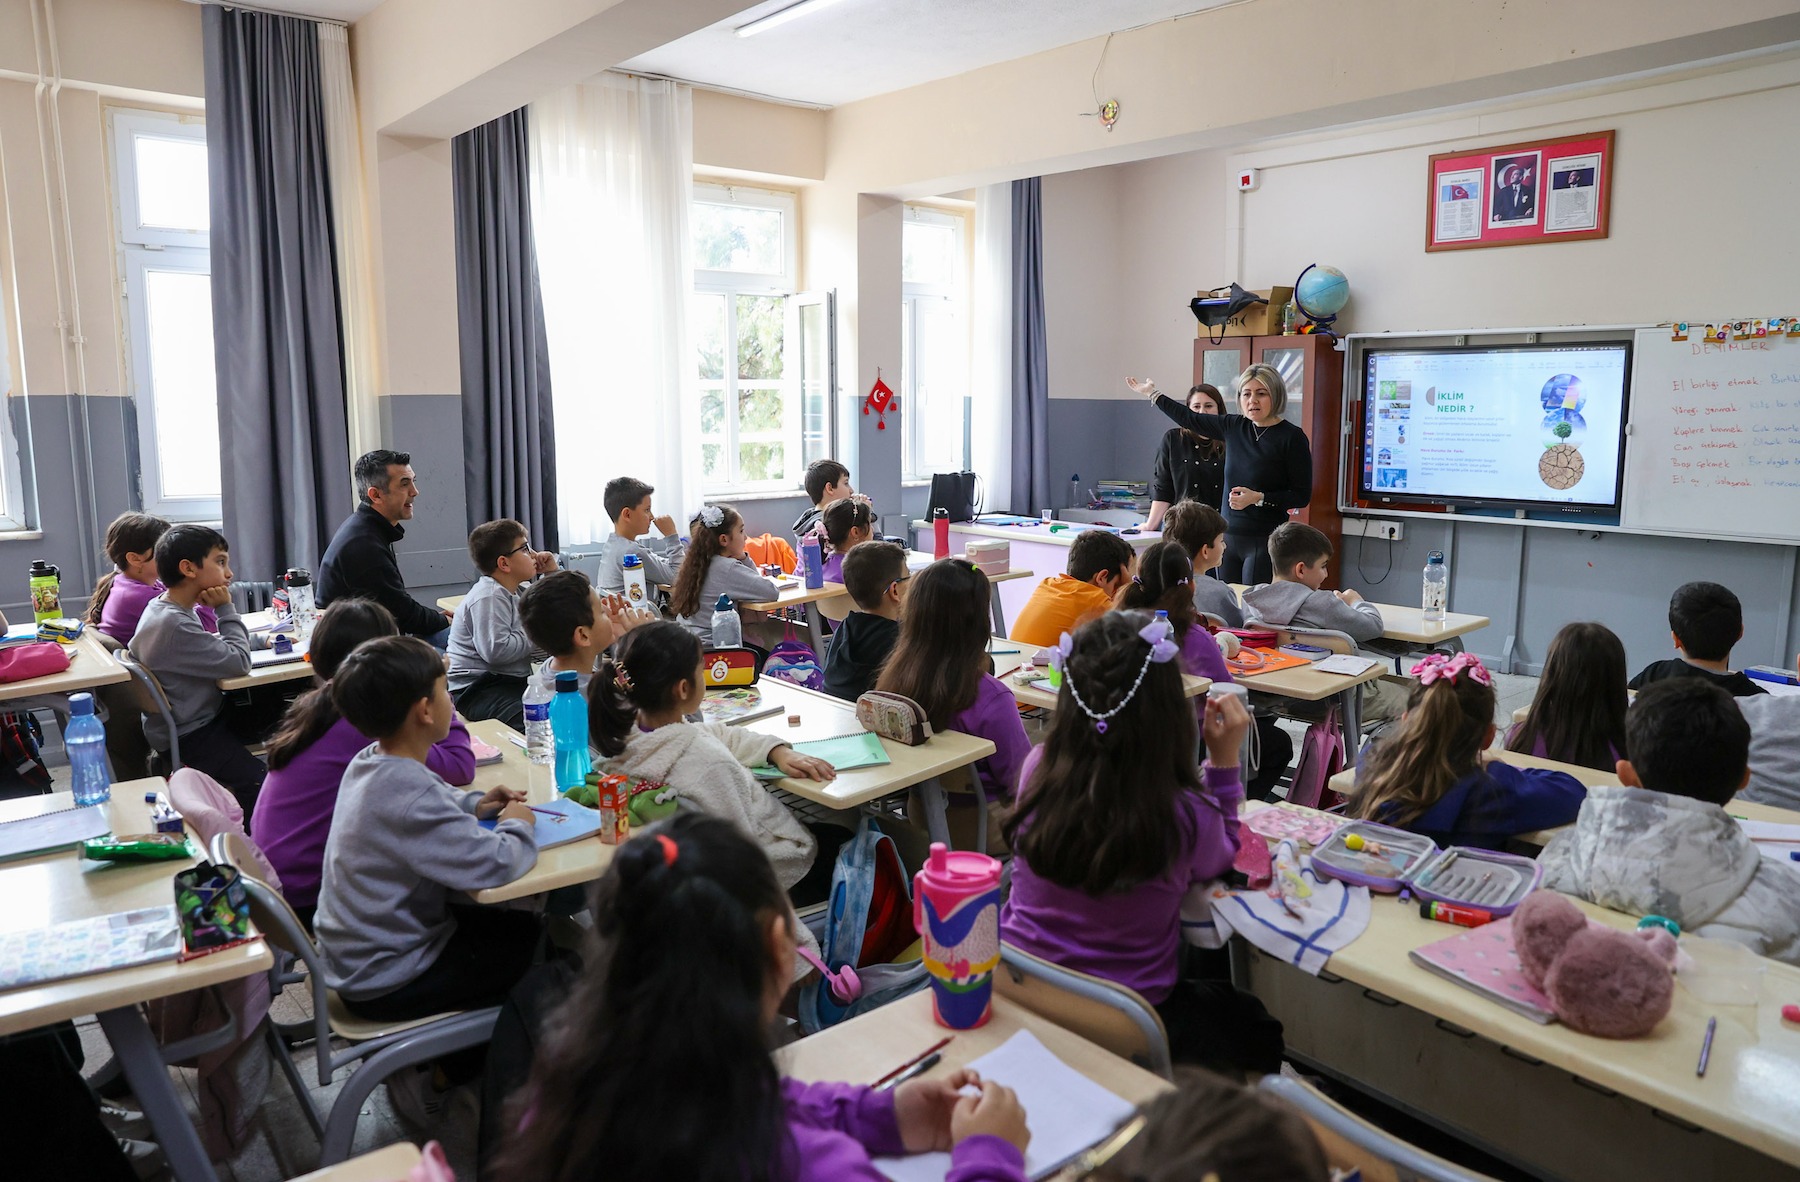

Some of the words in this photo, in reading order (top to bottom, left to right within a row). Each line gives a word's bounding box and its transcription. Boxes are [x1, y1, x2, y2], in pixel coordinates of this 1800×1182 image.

[1437, 390, 1464, 401] İKLİM
[1437, 403, 1466, 413] NEDİR
[1469, 405, 1475, 413] ?
[1673, 443, 1693, 451] Can
